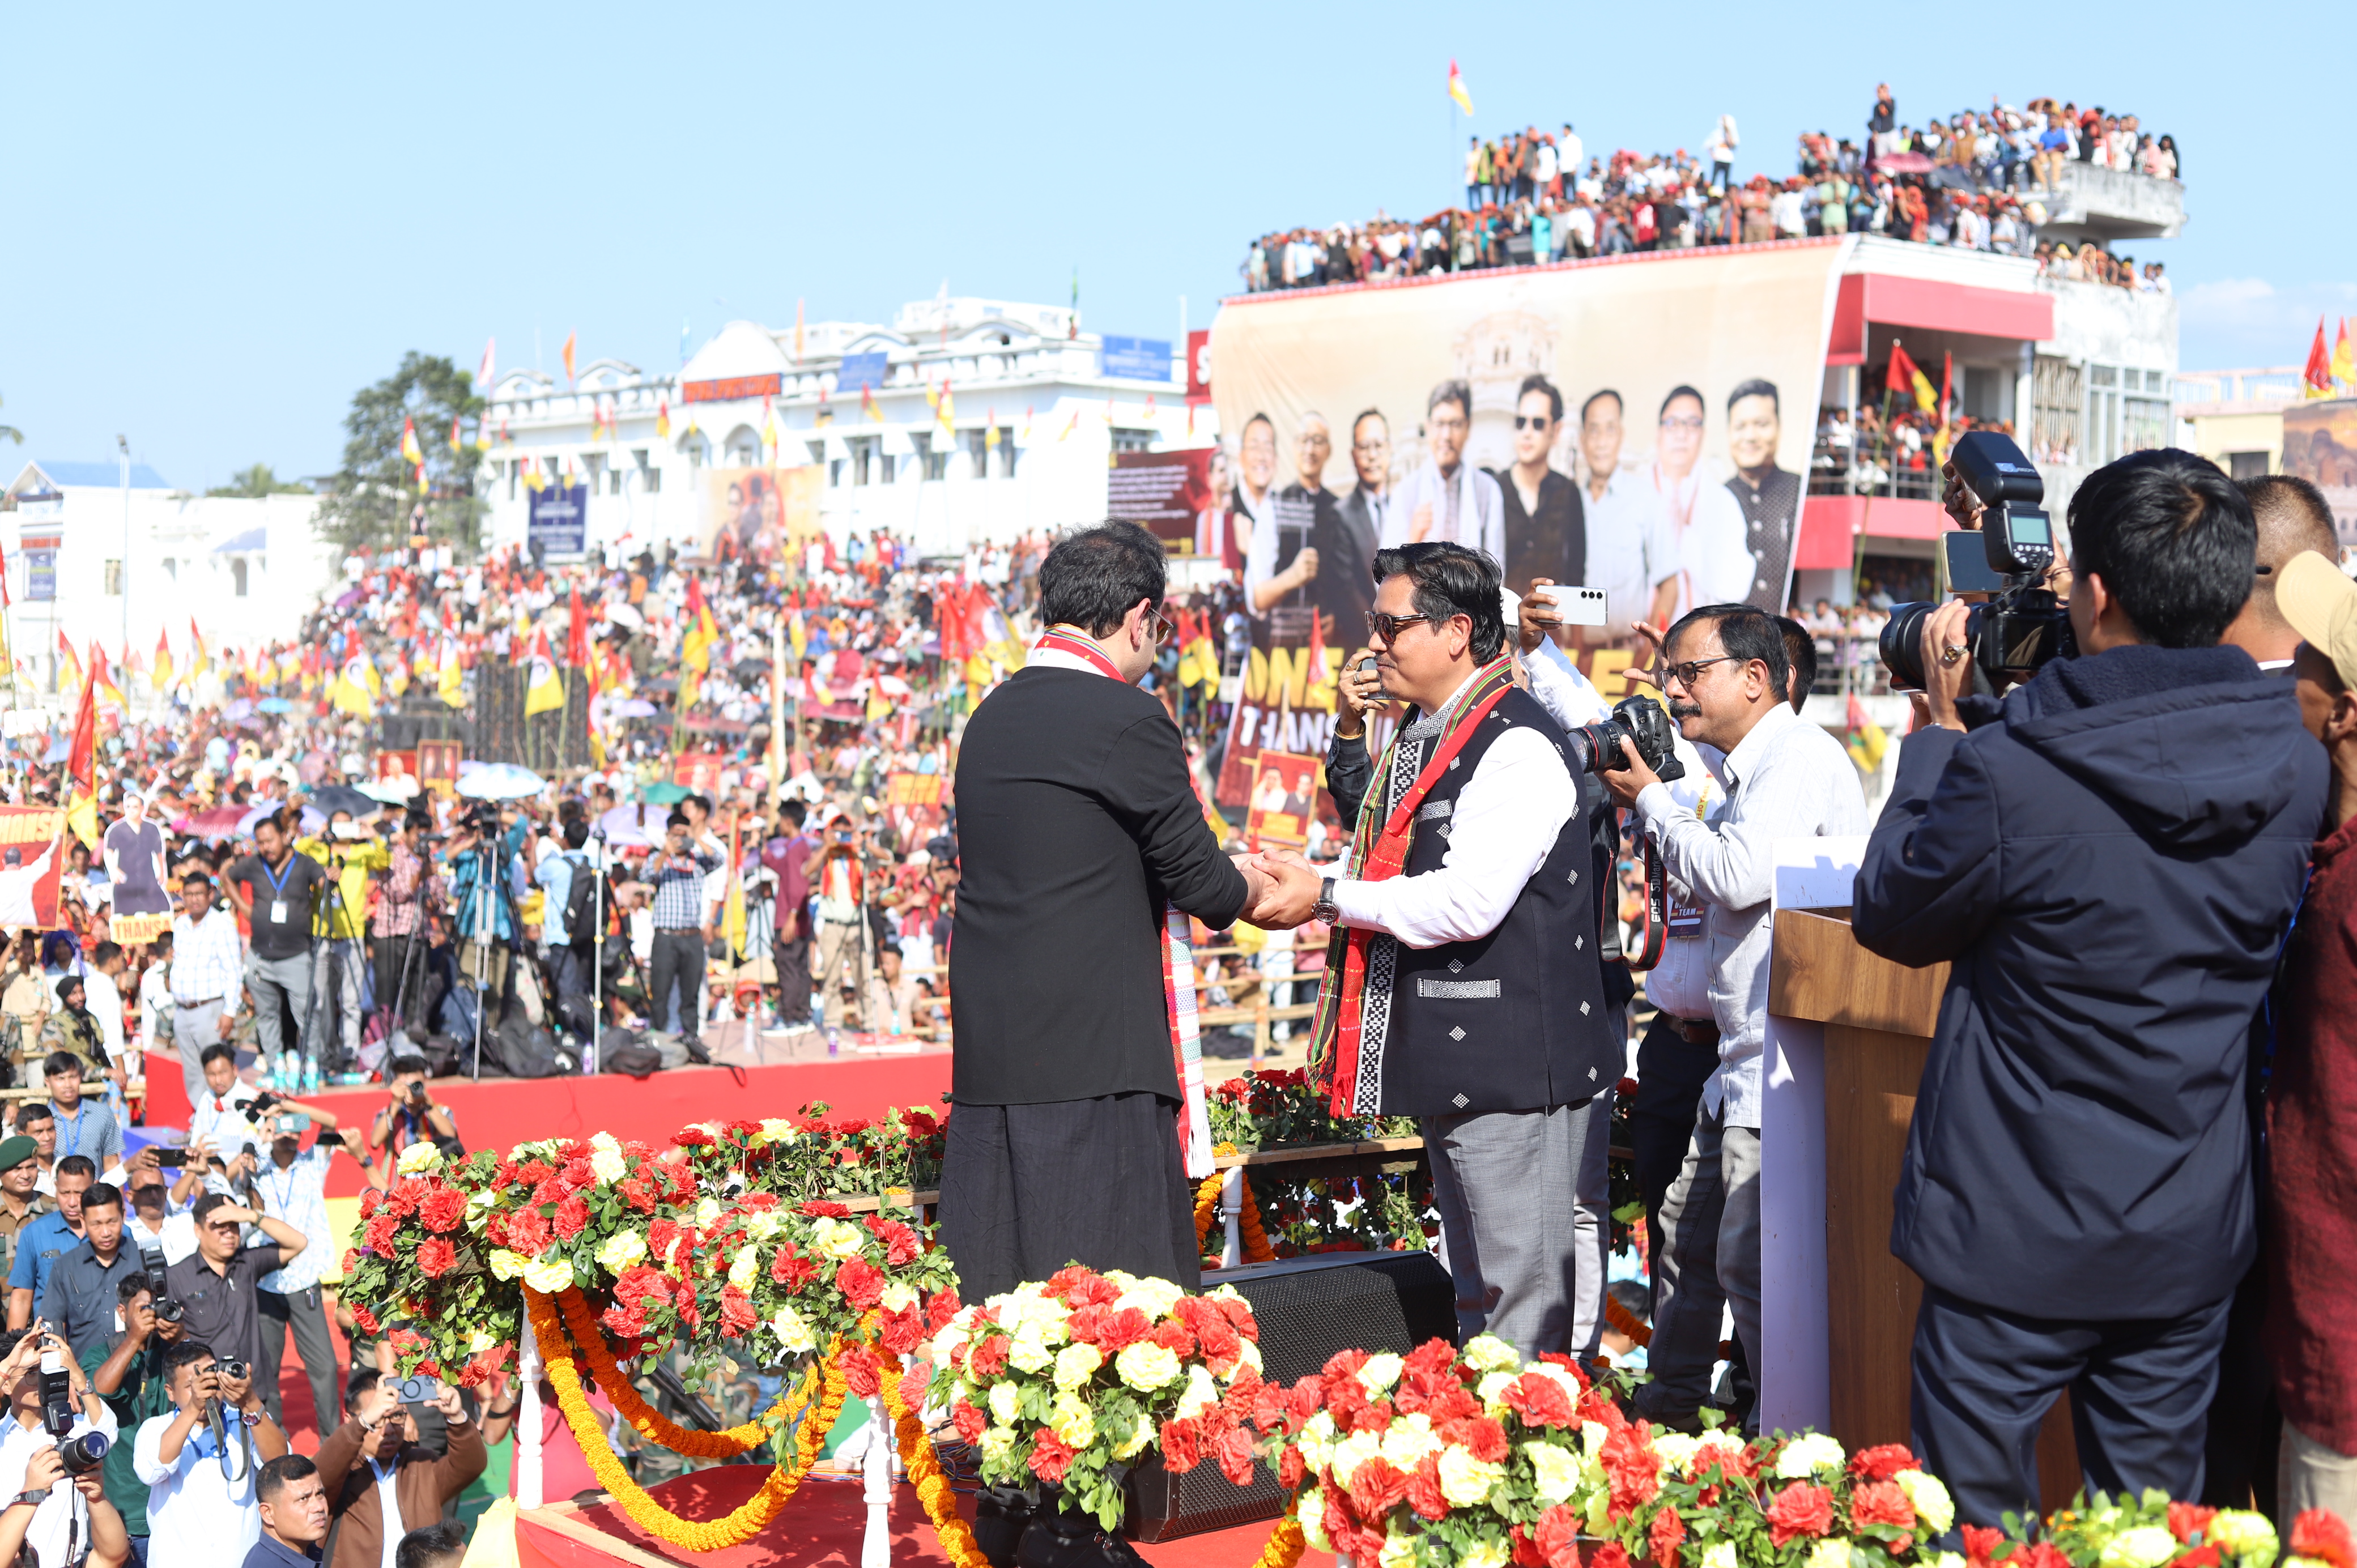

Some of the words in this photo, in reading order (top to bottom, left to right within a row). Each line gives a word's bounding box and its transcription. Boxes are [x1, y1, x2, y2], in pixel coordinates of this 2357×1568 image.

[1244, 646, 1345, 708] ONE
[1699, 785, 1709, 803] TIPRA
[1650, 898, 1661, 923] EOS
[1679, 908, 1696, 917] TEAM
[115, 919, 171, 939] THANSA
[66, 1544, 75, 1567] Canon
